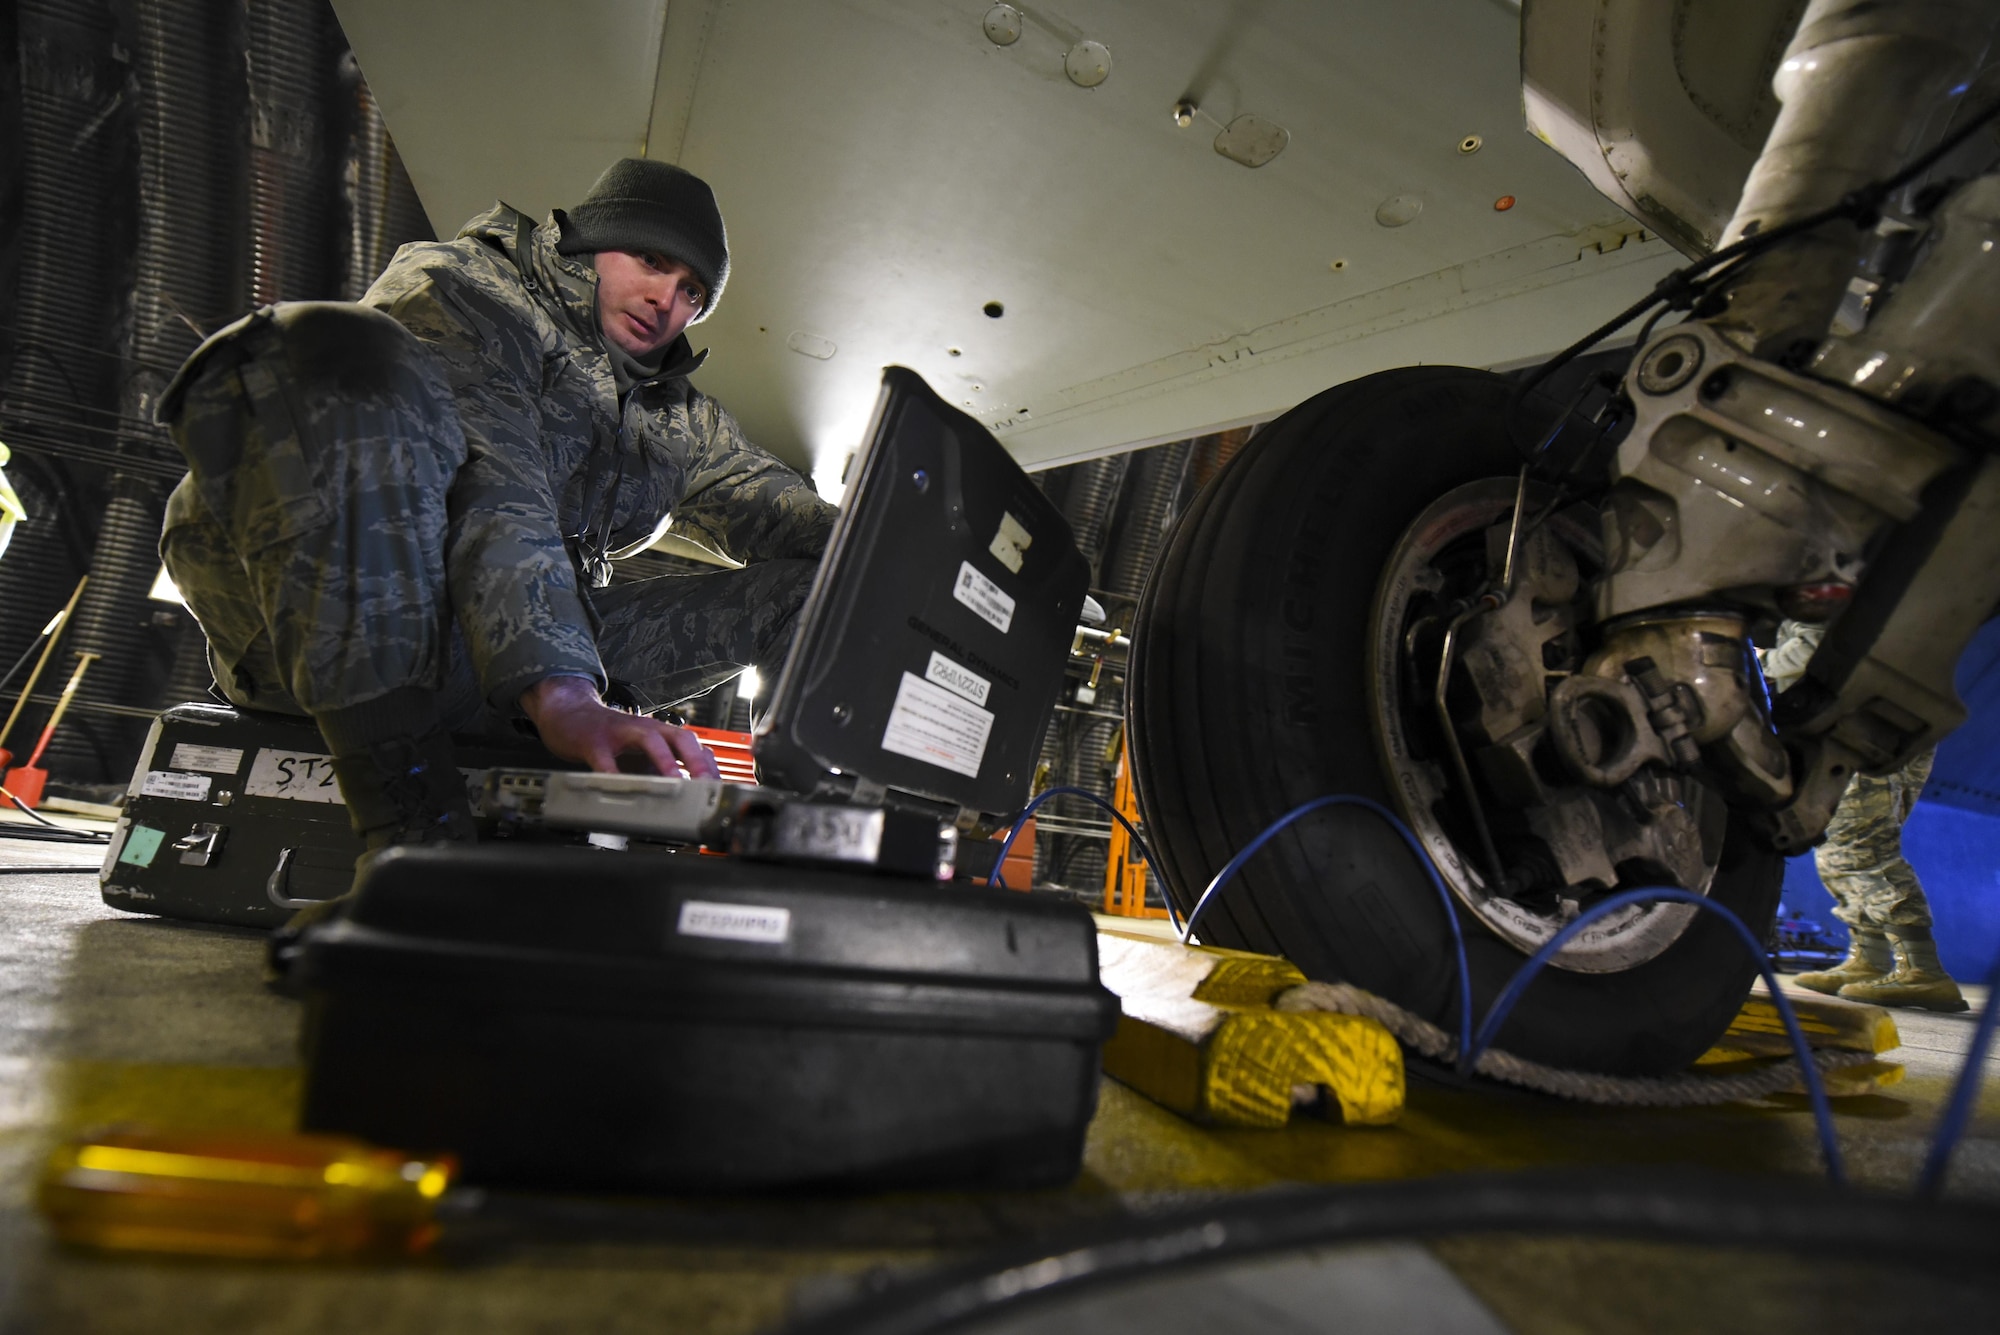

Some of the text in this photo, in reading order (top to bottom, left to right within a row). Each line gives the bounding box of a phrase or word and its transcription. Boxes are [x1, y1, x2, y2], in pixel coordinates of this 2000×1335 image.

[907, 615, 1021, 691] GENERAL DYNAMICS
[1284, 440, 1376, 727] MICHELIN
